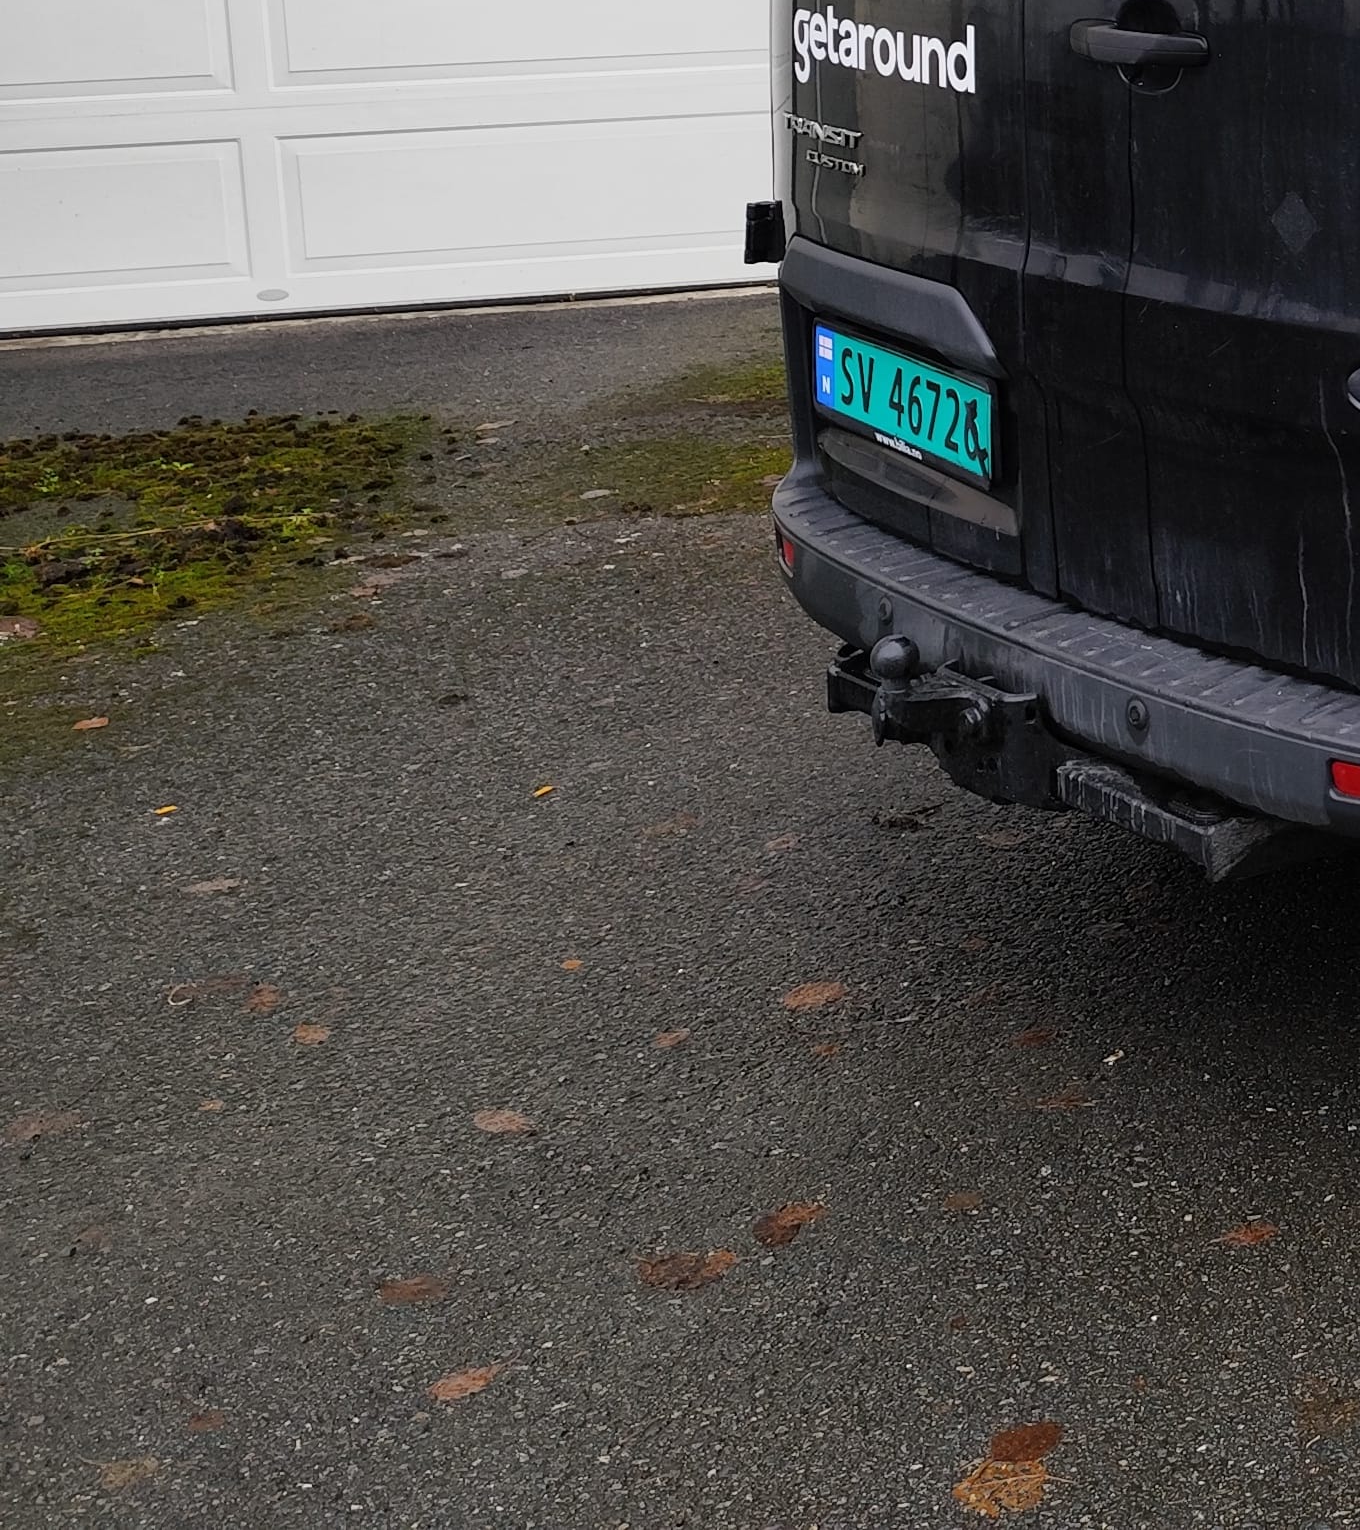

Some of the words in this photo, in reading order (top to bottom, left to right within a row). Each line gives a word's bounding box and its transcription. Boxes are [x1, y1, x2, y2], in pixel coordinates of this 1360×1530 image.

[793, 5, 976, 94] getaround
[783, 111, 864, 149] TRANSIT
[806, 150, 866, 177] CUSTOM
[821, 374, 831, 395] N
[841, 347, 875, 414] SV
